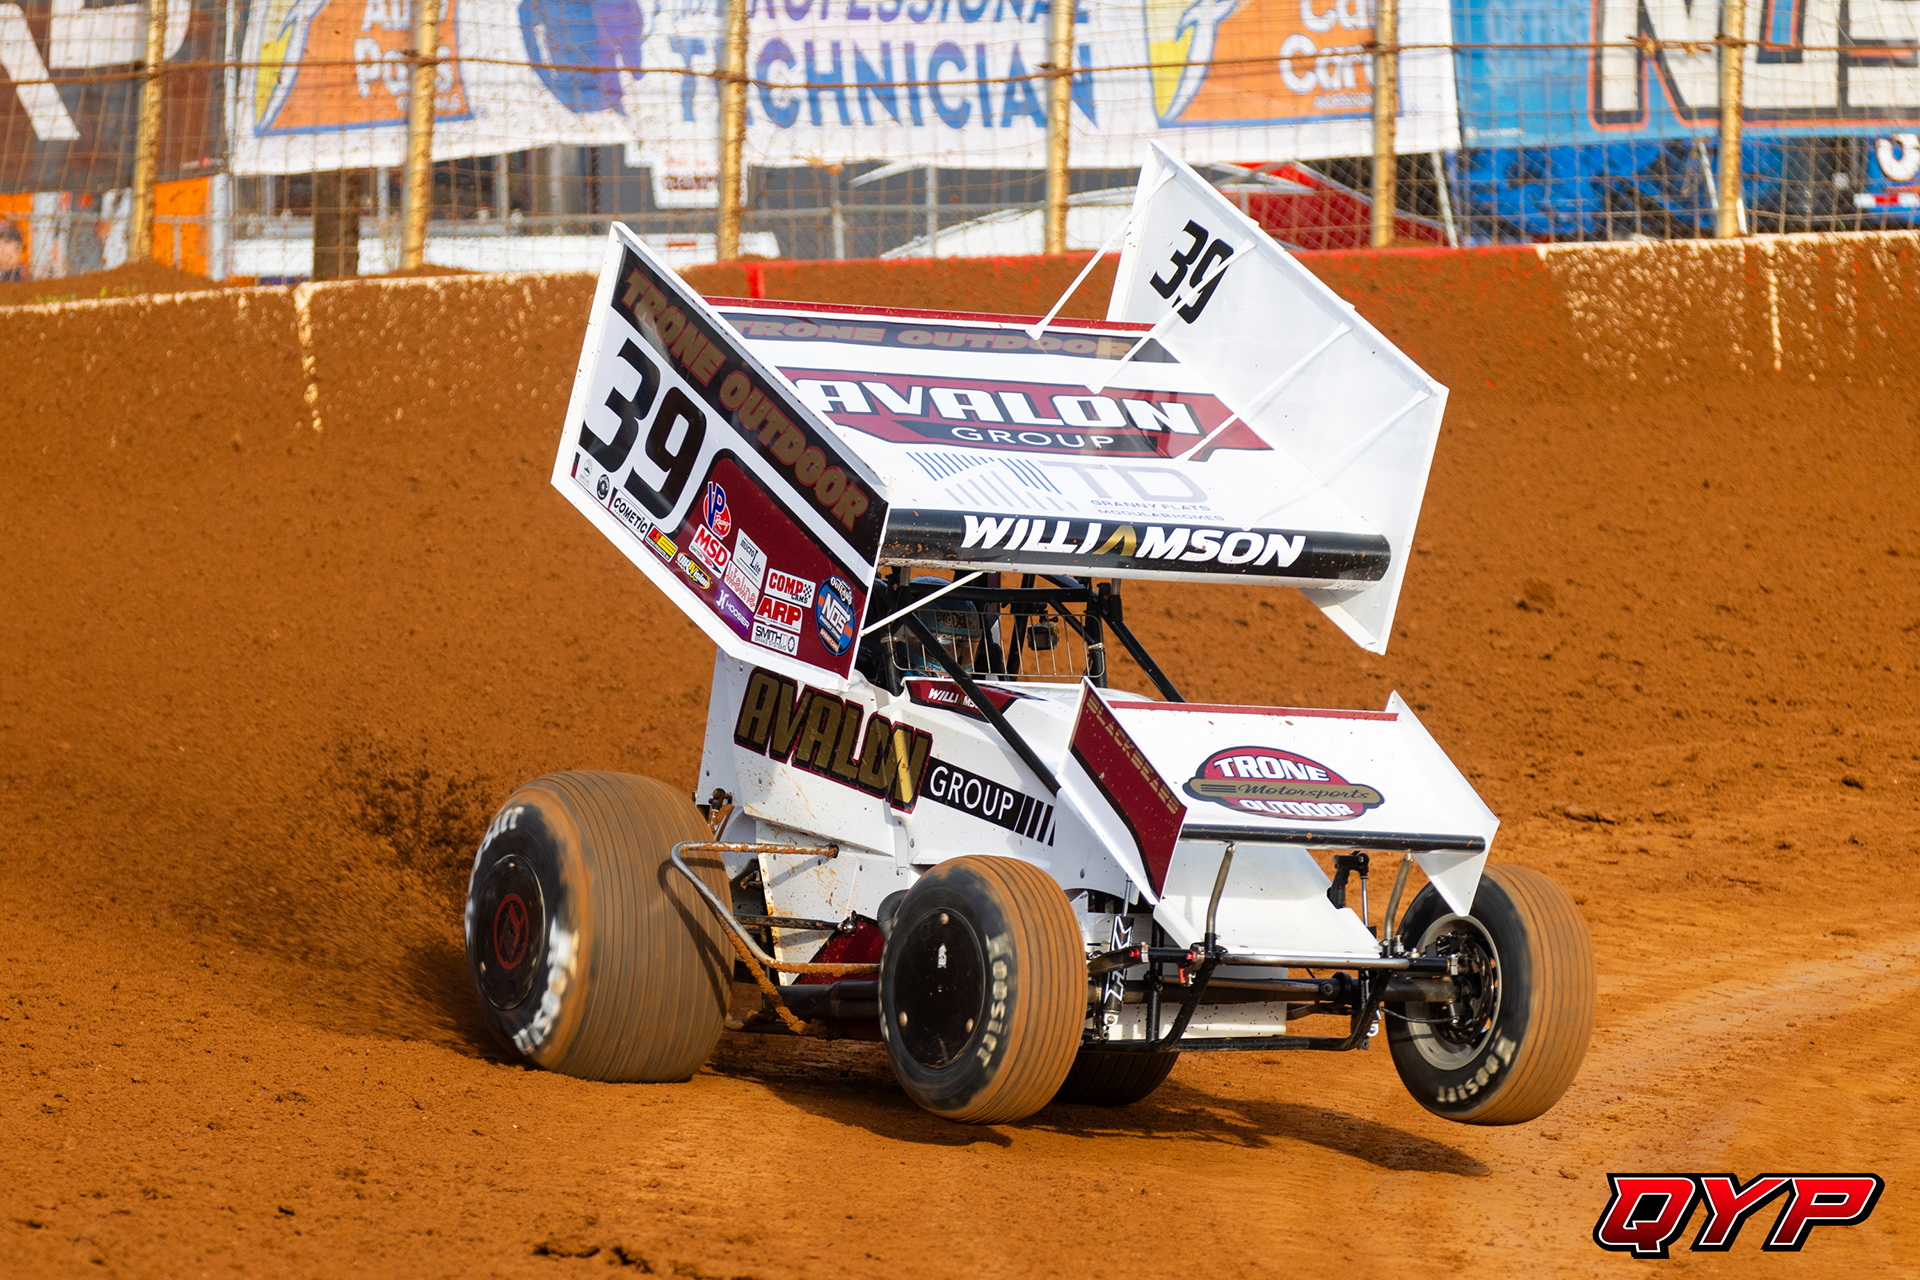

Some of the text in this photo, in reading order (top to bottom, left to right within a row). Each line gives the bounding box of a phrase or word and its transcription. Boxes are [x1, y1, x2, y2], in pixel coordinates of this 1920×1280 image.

[1149, 219, 1234, 324] 39
[621, 267, 727, 387] TRONE
[719, 370, 869, 532] OUTDOOR
[793, 379, 1202, 434] AVALON
[578, 337, 708, 520] 39
[952, 426, 1115, 449] GROUP
[613, 497, 648, 534] COMETIC
[707, 481, 727, 529] VP
[1090, 499, 1211, 512] GRANNY FLATS
[694, 527, 728, 567] MSD
[961, 515, 1306, 567] WILLIAMSON
[769, 572, 804, 596] COMP
[791, 593, 808, 604] CAMS
[726, 601, 750, 630] HOOSIER
[757, 597, 801, 626] ARP
[821, 592, 851, 634] NOS
[928, 688, 980, 709] WILLIAMS
[734, 666, 1015, 820] AVALON GROUP
[1213, 755, 1331, 782] TRONE
[1237, 783, 1371, 801] Motorsports
[1238, 798, 1356, 817] OUTDOOR
